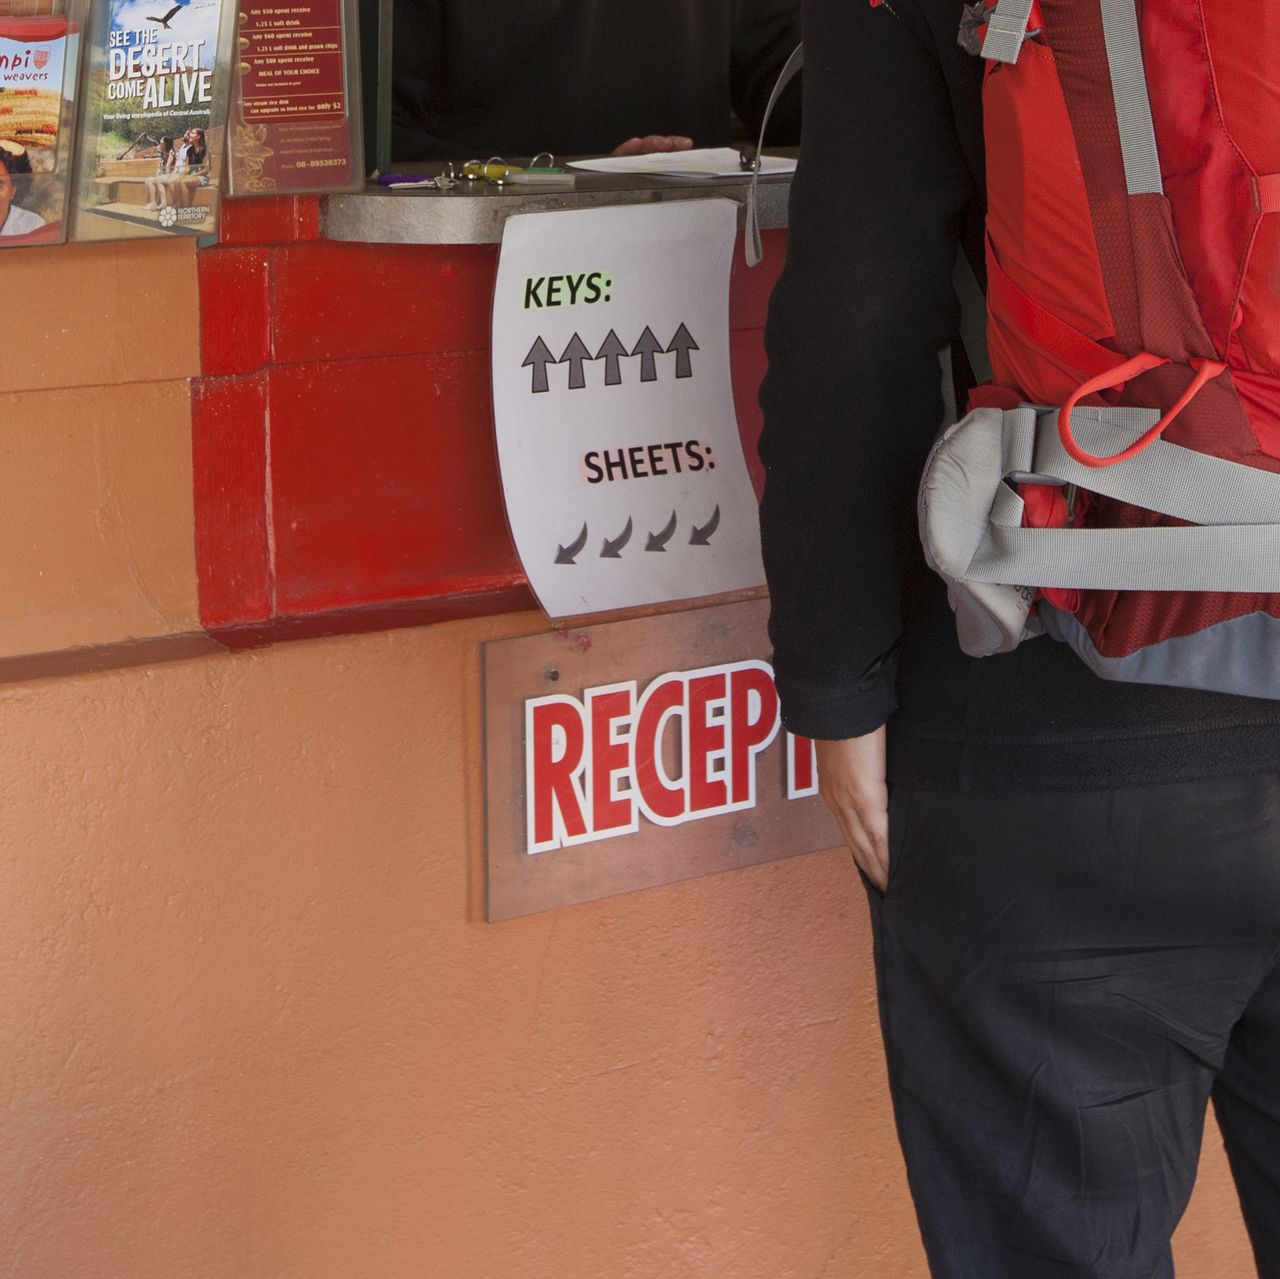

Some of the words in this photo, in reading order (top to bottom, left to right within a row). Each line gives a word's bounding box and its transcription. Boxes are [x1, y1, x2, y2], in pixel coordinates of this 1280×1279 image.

[109, 30, 133, 48] SEE
[135, 28, 158, 45] THE
[3, 71, 49, 82] weavers
[108, 39, 207, 82] DESERT
[108, 78, 145, 101] COME
[144, 71, 213, 110] ALIVE
[522, 271, 613, 309] KEYS:
[583, 439, 716, 485] SHEETS:
